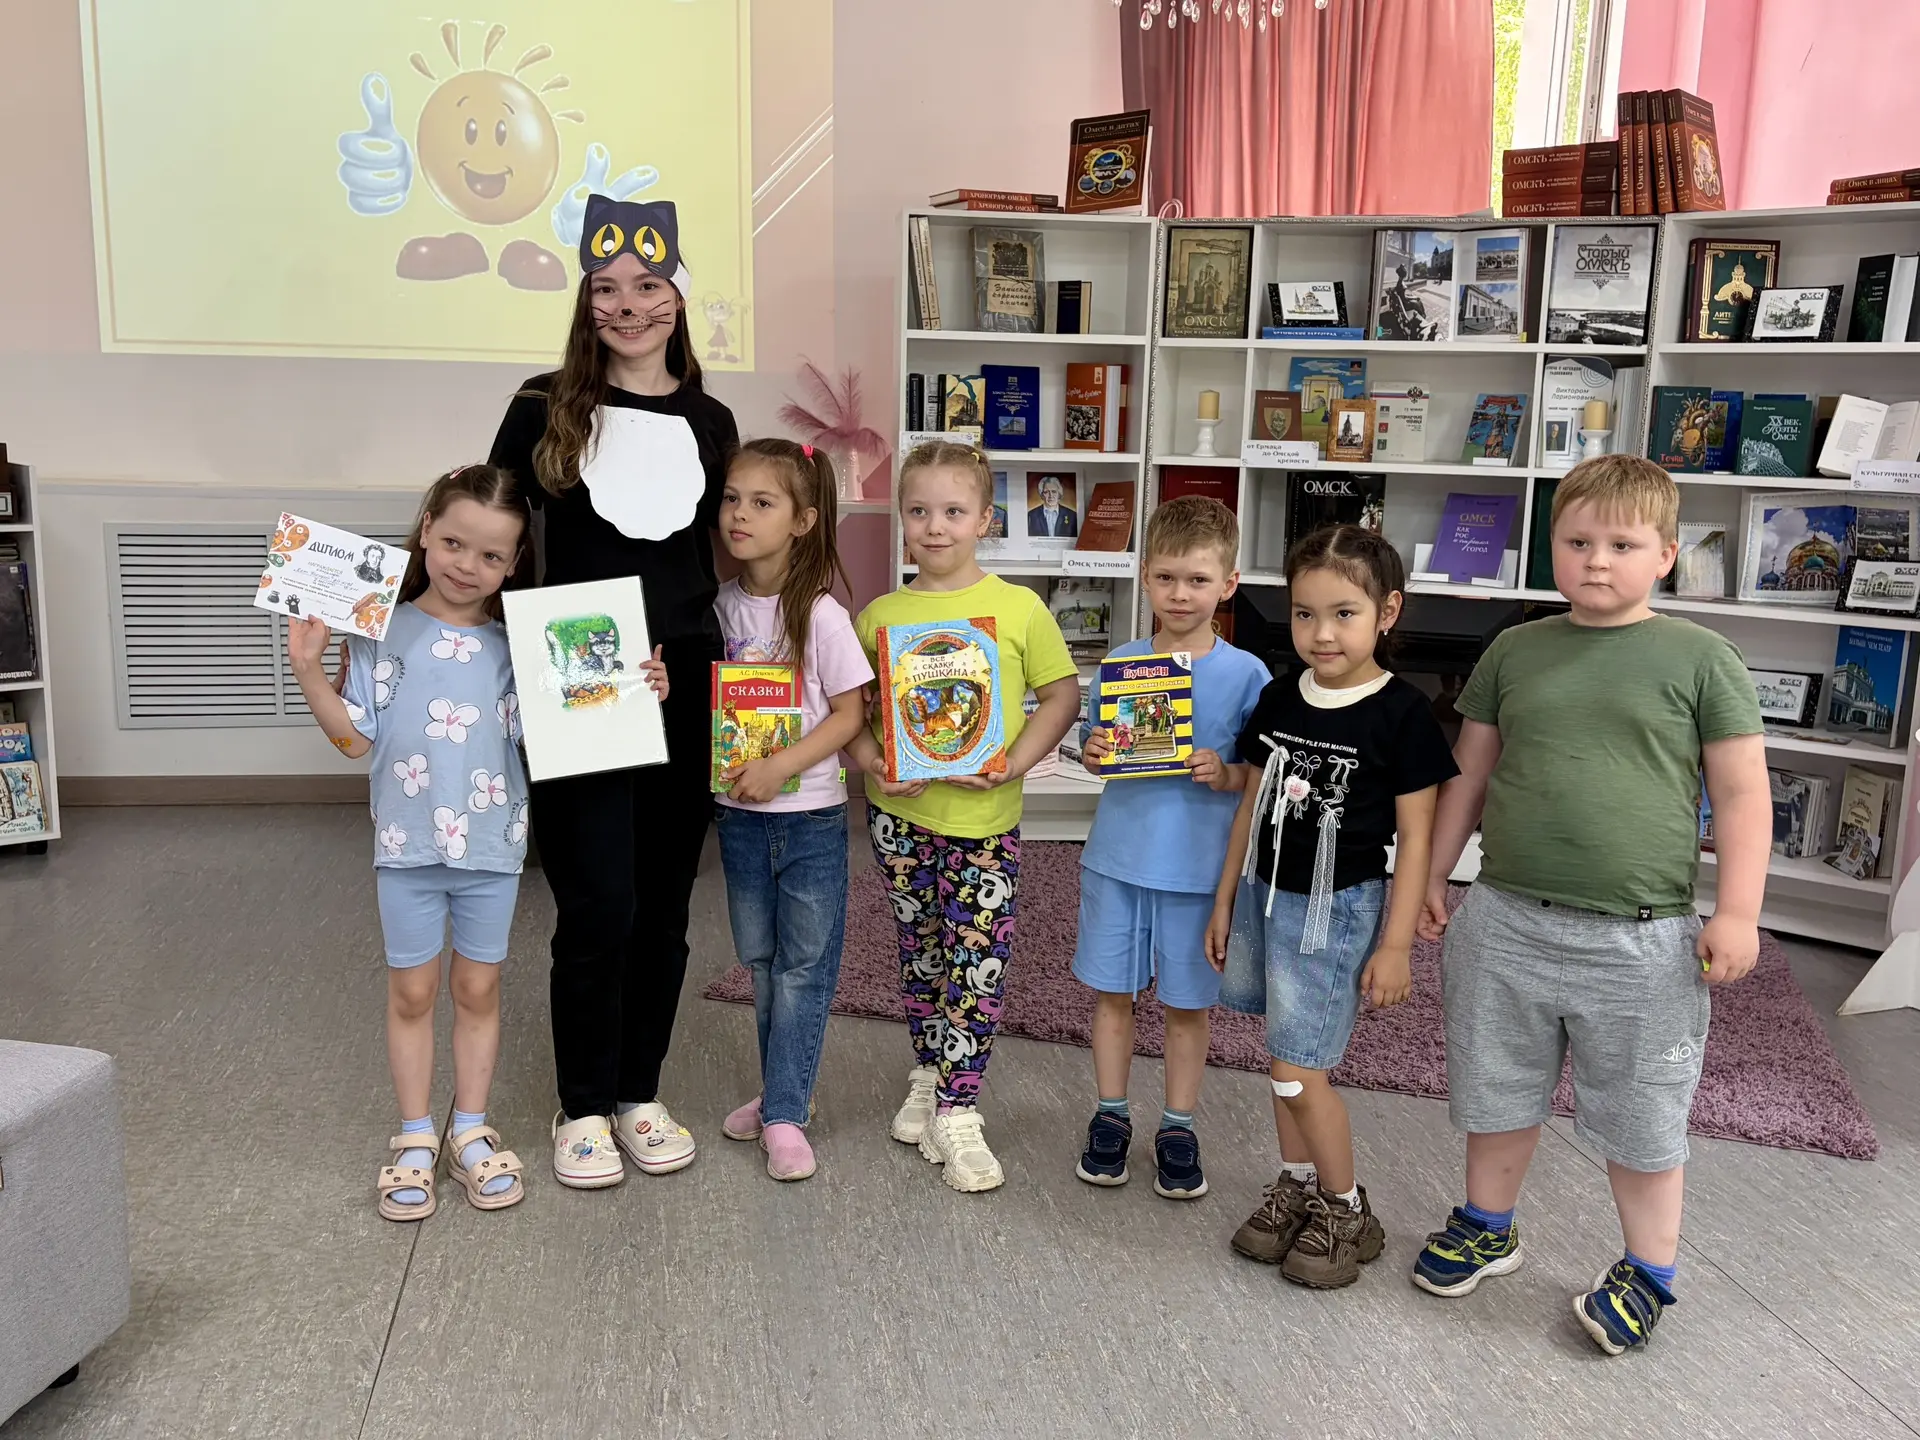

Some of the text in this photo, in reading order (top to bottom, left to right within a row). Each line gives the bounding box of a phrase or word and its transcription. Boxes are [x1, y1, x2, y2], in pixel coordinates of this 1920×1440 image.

[1514, 154, 1548, 164] ОМСКЪ
[1512, 180, 1546, 190] ОМСКЪ
[1848, 180, 1868, 188] Омск
[1875, 176, 1898, 184] лицах
[970, 192, 1004, 200] ХРОНОГРАФ
[1007, 194, 1028, 202] ОМСКА
[1848, 194, 1870, 202] Омск
[1878, 192, 1904, 200] лицах
[978, 202, 1035, 212] ХРОНОГРАФ ОМСКА
[1512, 204, 1545, 214] ОМСКЪ
[1184, 316, 1228, 326] ОМСК
[1861, 470, 1908, 478] КУЛЬТУРНАЯ
[1304, 480, 1352, 494] ОМСК
[1460, 513, 1496, 523] ОМСК
[308, 541, 354, 562] ДИПЛОМ
[1068, 560, 1090, 568] Омск
[922, 661, 954, 670] СКАЗКИ
[912, 668, 968, 682] ПУШКИНА
[728, 686, 785, 696] СКАЗКИ
[1306, 740, 1318, 748] FILE
[1331, 742, 1358, 754] MACHINE
[1662, 1046, 1692, 1061] alo
